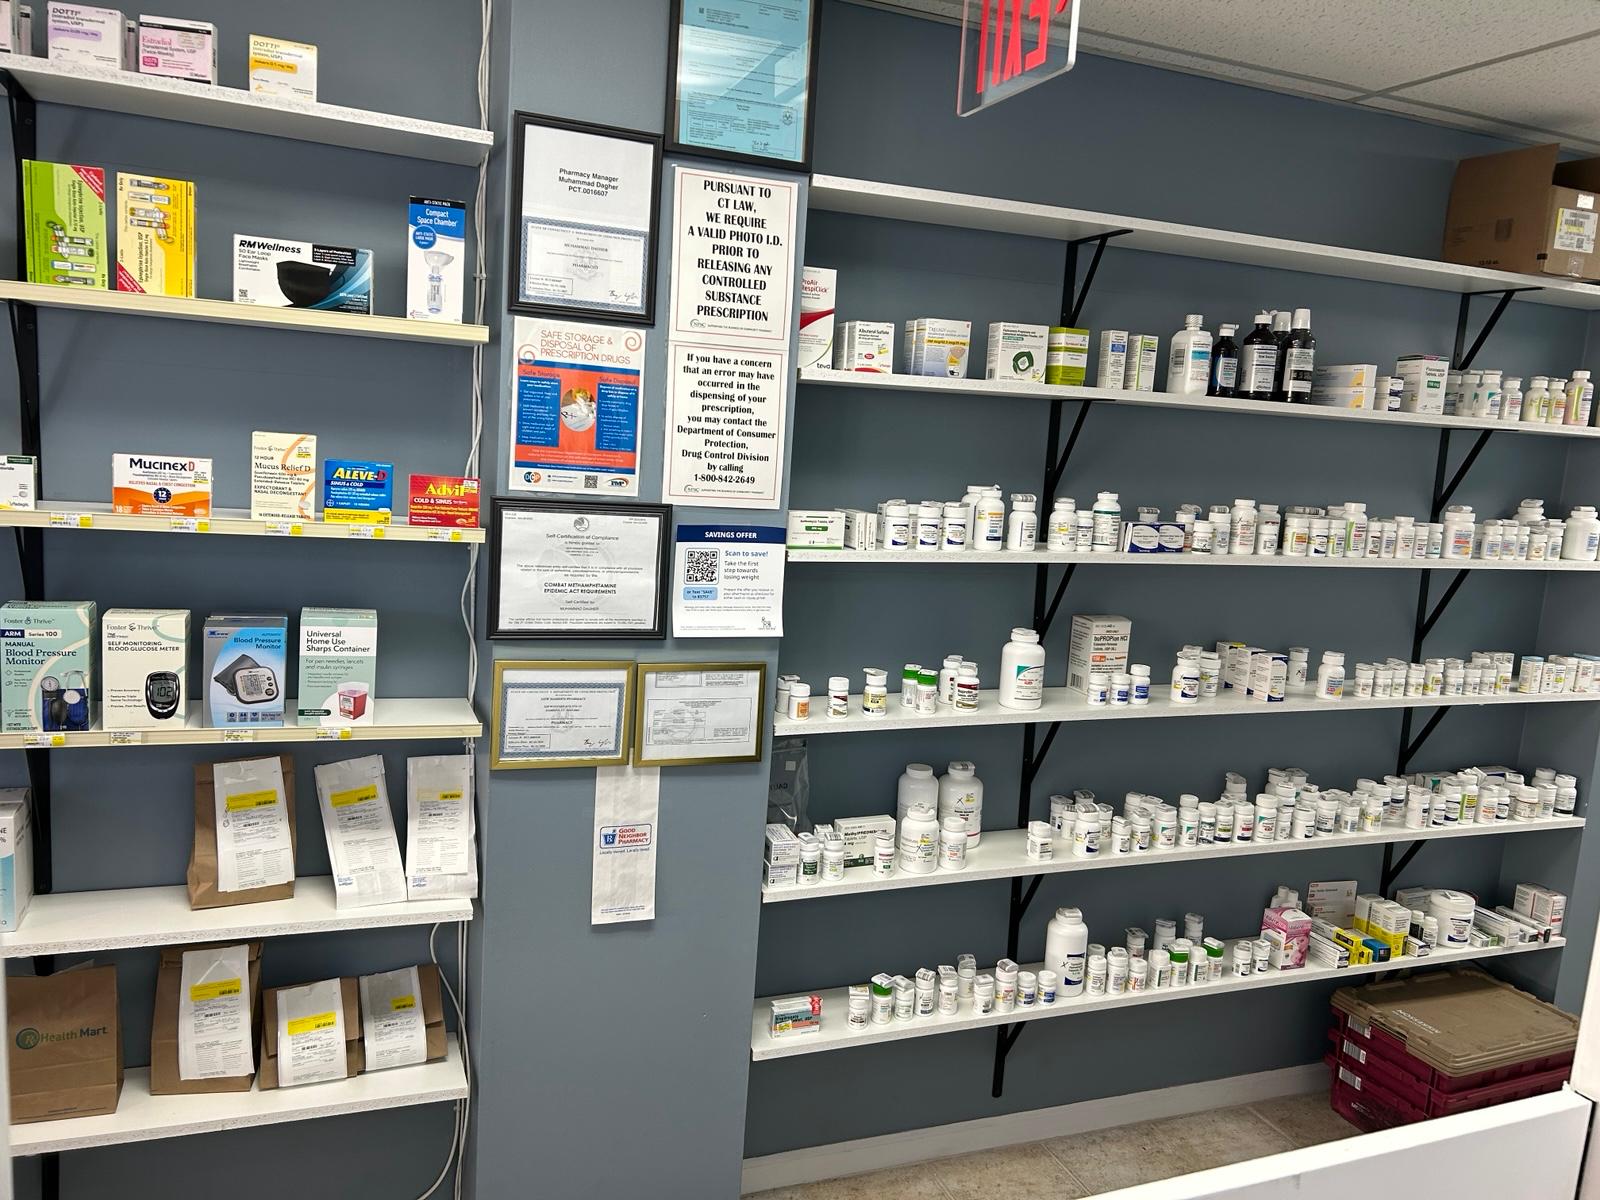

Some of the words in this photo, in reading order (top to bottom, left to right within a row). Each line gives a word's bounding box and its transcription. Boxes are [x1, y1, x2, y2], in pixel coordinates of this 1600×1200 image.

[52, 7, 78, 17] DOTTI
[142, 35, 172, 46] Estradiol
[253, 40, 279, 49] DOTTI
[559, 167, 590, 181] Pharmacy
[591, 172, 619, 183] Manager
[558, 176, 595, 188] Muhammad
[596, 180, 619, 191] Dagher
[703, 180, 756, 197] PURSUANT
[758, 186, 772, 199] TO
[717, 197, 731, 209] CT
[733, 199, 757, 213] LAW,
[425, 208, 449, 219] Compact
[416, 216, 433, 226] Space
[434, 218, 457, 227] Chamber
[705, 211, 721, 224] WE
[723, 213, 767, 229] REQUIRE
[687, 225, 695, 236] A
[697, 226, 726, 240] VALID
[729, 230, 763, 244] PHOTO
[766, 234, 783, 247] I.D.
[257, 250, 272, 258] Loop
[711, 243, 743, 257] PRIOR
[746, 247, 760, 259] TO
[697, 257, 751, 274] RELEASING
[753, 264, 773, 277] ANY
[702, 274, 767, 291] CONTROLLED
[704, 289, 762, 306] SUBSTANCE
[696, 304, 769, 322] PRESCRIPTION
[540, 330, 564, 340] SAFE
[564, 332, 604, 345] STORAGE
[607, 337, 613, 345] &
[540, 339, 582, 351] DISPOSAL
[583, 344, 597, 352] OF
[540, 348, 599, 362] PRESCRIPTION
[600, 354, 631, 366] DRUGS
[687, 353, 695, 362] If
[695, 356, 711, 364] you
[713, 355, 731, 365] have
[740, 359, 772, 368] concern
[683, 365, 700, 374] that
[714, 368, 737, 378] error
[738, 371, 755, 381] may
[756, 371, 775, 381] have
[697, 379, 734, 389] occurred
[736, 381, 746, 389] in
[747, 382, 761, 391] the
[690, 390, 736, 403] dispensing
[737, 393, 747, 402] of
[748, 395, 767, 404] your
[701, 403, 755, 415] prescription,
[687, 414, 703, 424] you
[704, 416, 721, 426] may
[722, 417, 753, 427] contact
[754, 418, 768, 427] the
[677, 425, 724, 437] Department
[725, 427, 735, 436] of
[736, 428, 777, 439] Consumer
[704, 438, 749, 450] Protection,
[681, 449, 703, 461] Drug
[704, 450, 735, 460] Control
[736, 452, 770, 462] Division
[129, 457, 188, 472] Mucinex
[188, 461, 195, 472] D
[254, 462, 280, 471] Mucus
[281, 463, 303, 472] Relief
[707, 462, 718, 472] by
[719, 463, 744, 474] calling
[333, 467, 388, 481] ALEVE-D
[693, 473, 756, 484] 1-800-842-2649
[425, 483, 466, 497] Advil
[115, 505, 123, 513] 18
[592, 534, 619, 542] Compliance
[704, 531, 735, 539] SAVINGS
[736, 532, 758, 540] OFFER
[751, 550, 769, 558] save!
[724, 567, 736, 575] step
[106, 623, 127, 631] Foster
[306, 630, 342, 639] Universal
[254, 637, 282, 645] Pressure
[5, 648, 34, 658] Blood
[35, 648, 77, 658] Pressure
[306, 645, 332, 655] Sharps
[5, 656, 46, 666] Monitor
[333, 665, 354, 673] syringes
[156, 687, 173, 698] 102
[618, 832, 648, 840] NEIGHBOR
[618, 837, 649, 845] PHARMACY
[40, 1030, 77, 1045] Health
[78, 1026, 105, 1039] Mart
